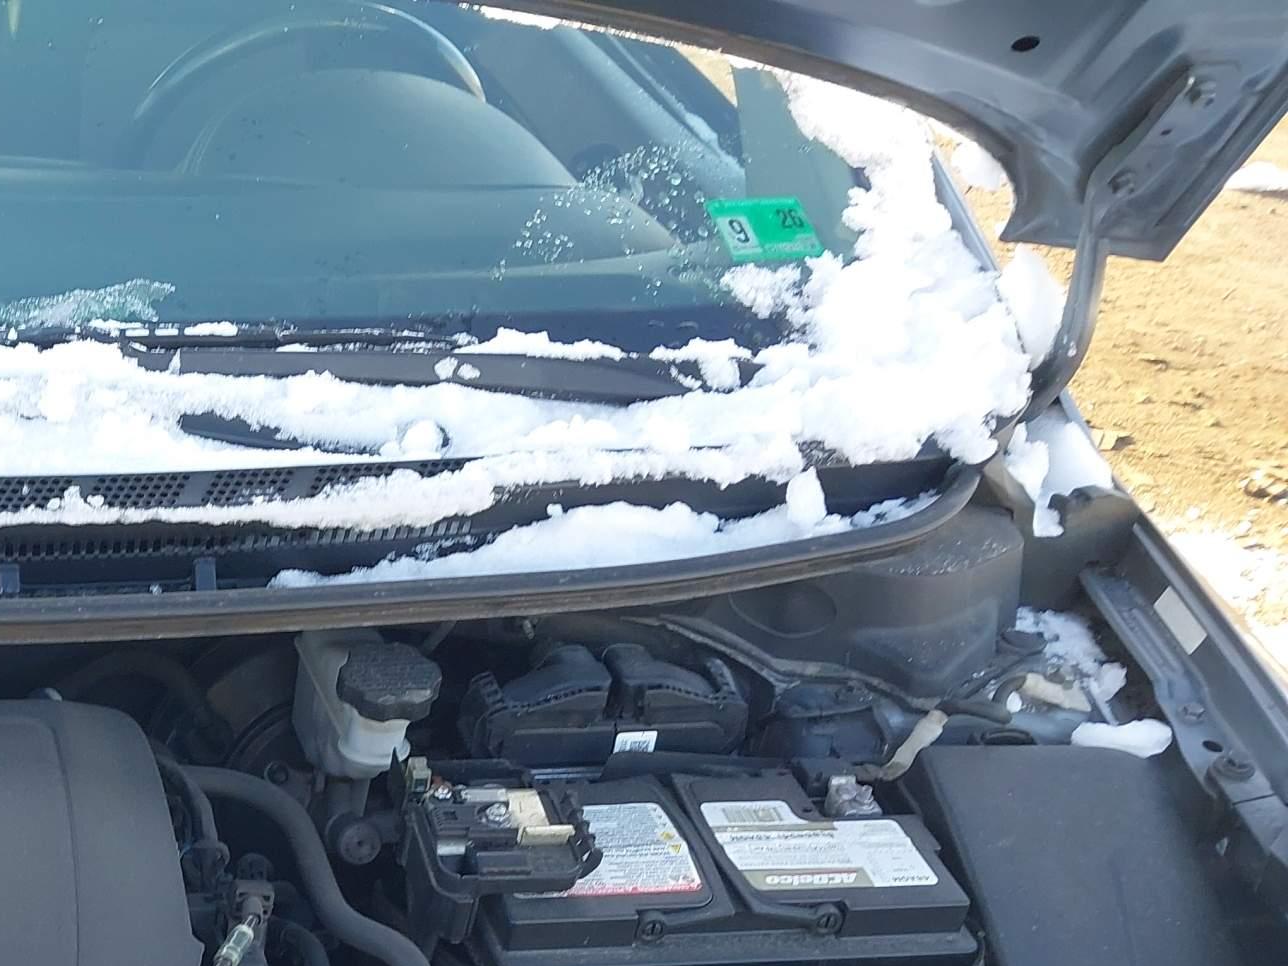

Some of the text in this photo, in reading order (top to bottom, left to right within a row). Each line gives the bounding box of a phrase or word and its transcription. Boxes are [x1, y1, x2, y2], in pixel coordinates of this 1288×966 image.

[775, 208, 804, 229] 26
[728, 218, 750, 244] 9
[765, 871, 858, 886] ACDelco
